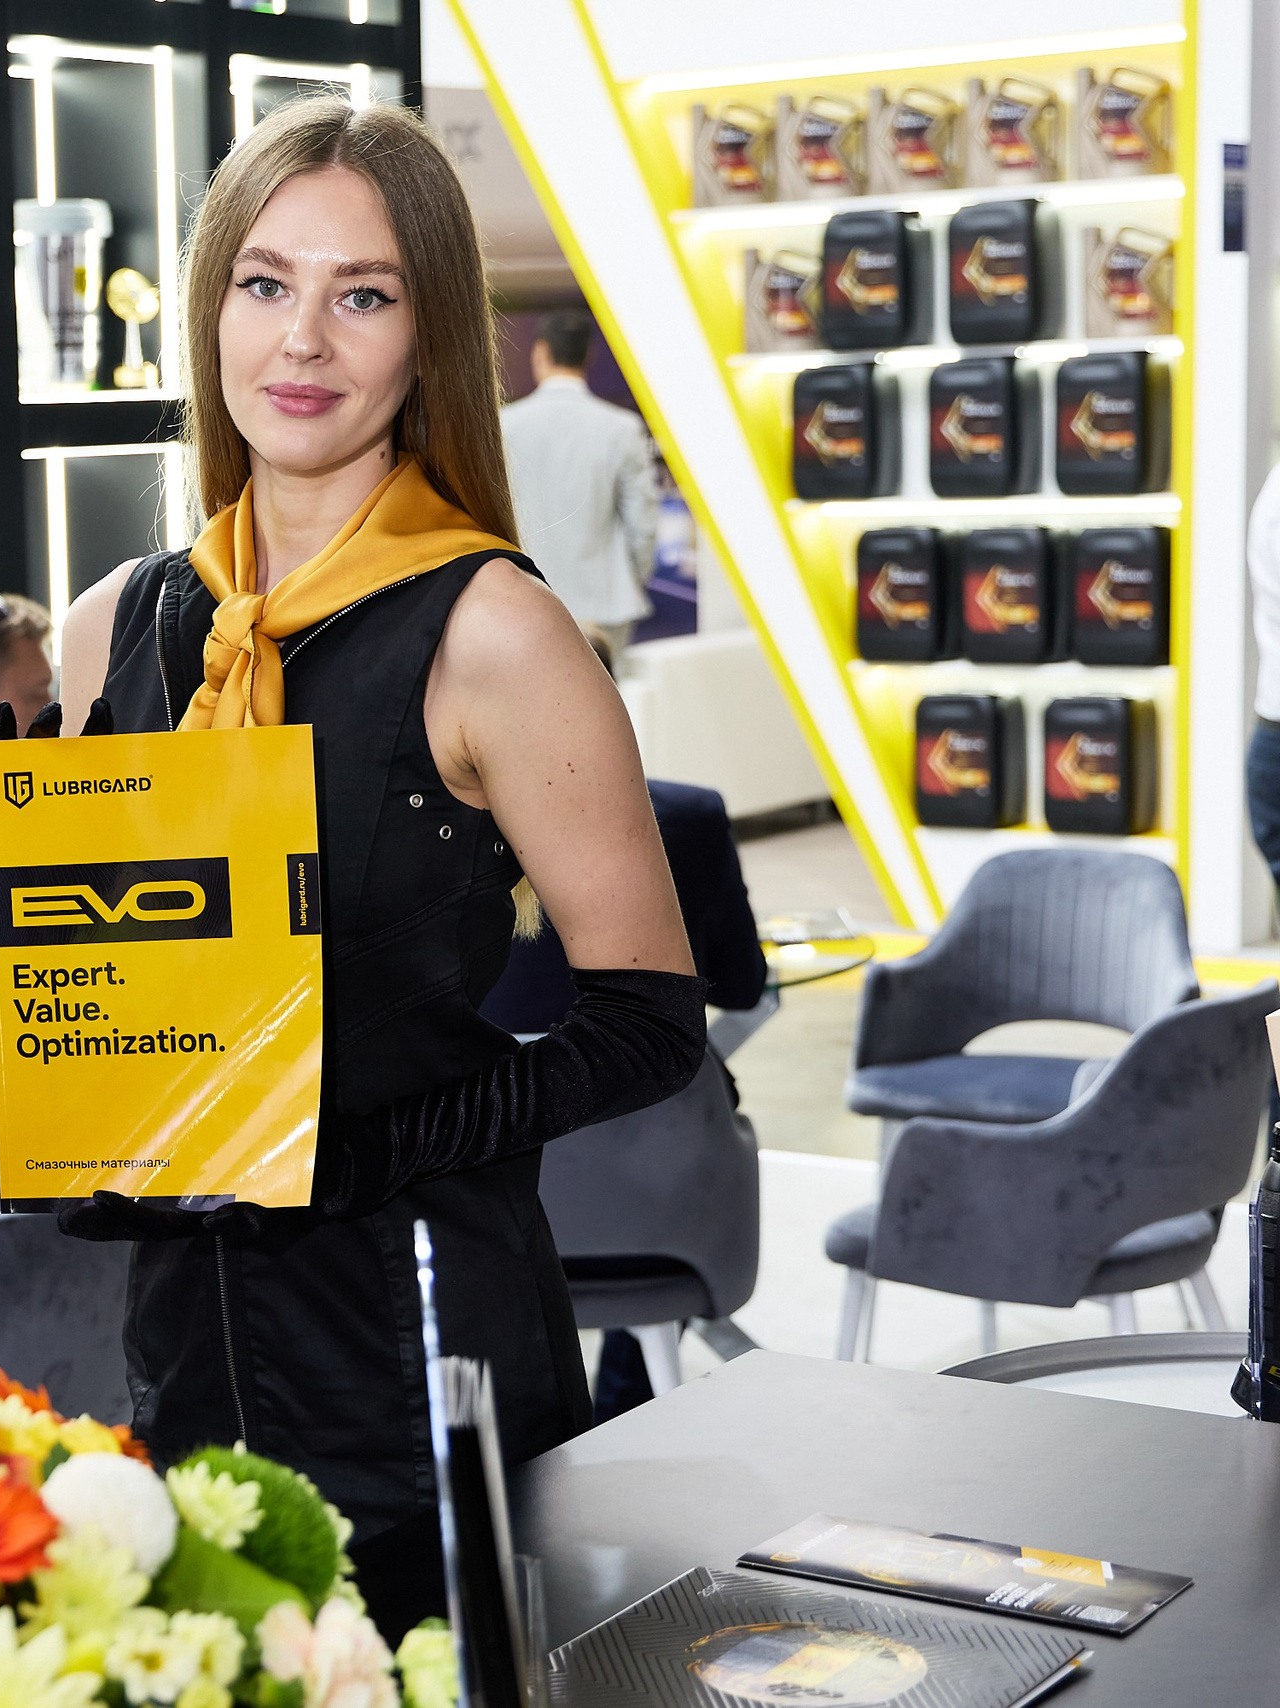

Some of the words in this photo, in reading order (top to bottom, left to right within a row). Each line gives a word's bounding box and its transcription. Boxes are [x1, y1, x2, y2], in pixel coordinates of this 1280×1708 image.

[43, 777, 152, 796] LUBRIGARD
[11, 880, 206, 927] EVO
[297, 862, 308, 926] lubrigard.ru/evo
[13, 962, 126, 995] Expert.
[13, 998, 110, 1024] Value.
[16, 1026, 226, 1065] Optimization.
[25, 1159, 98, 1170] Смазочные
[101, 1158, 170, 1170] материалы
